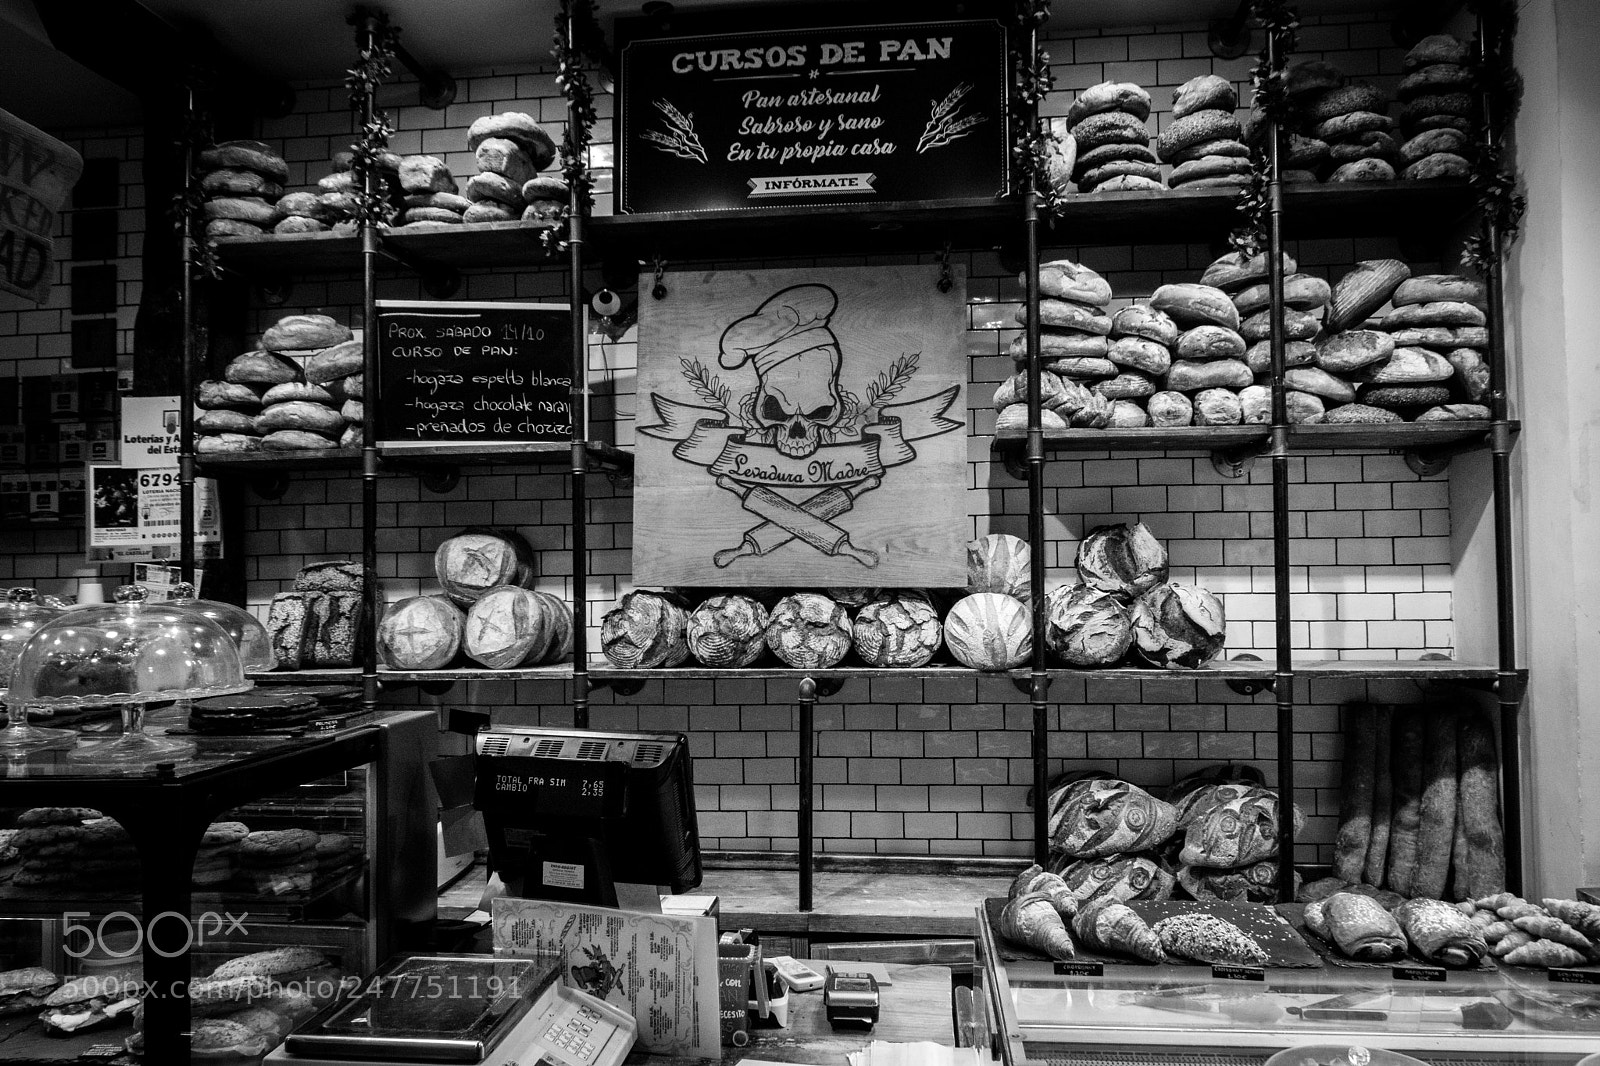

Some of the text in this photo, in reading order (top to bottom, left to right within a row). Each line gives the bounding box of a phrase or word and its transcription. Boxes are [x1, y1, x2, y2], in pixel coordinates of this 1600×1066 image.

[672, 37, 953, 74] CURSOS DE PAN
[741, 83, 882, 108] Pan artesanal
[738, 113, 886, 140] Sabroso y sano
[727, 138, 897, 165] En tu propia casa
[764, 177, 860, 191] INFÓRMATE
[501, 323, 545, 341] 14/10
[391, 345, 519, 358] CURSO DE PAN:
[472, 368, 525, 389] espelta
[531, 369, 572, 387] blanca
[474, 393, 534, 412] chocolate
[493, 417, 512, 434] de
[124, 434, 164, 444] Loterías
[165, 437, 172, 445] y
[148, 445, 181, 455] del Esta
[728, 454, 869, 483] Levadura Madre
[495, 782, 529, 793] CAMBIO
[496, 774, 523, 784] TOTAL
[528, 776, 545, 786] FRA
